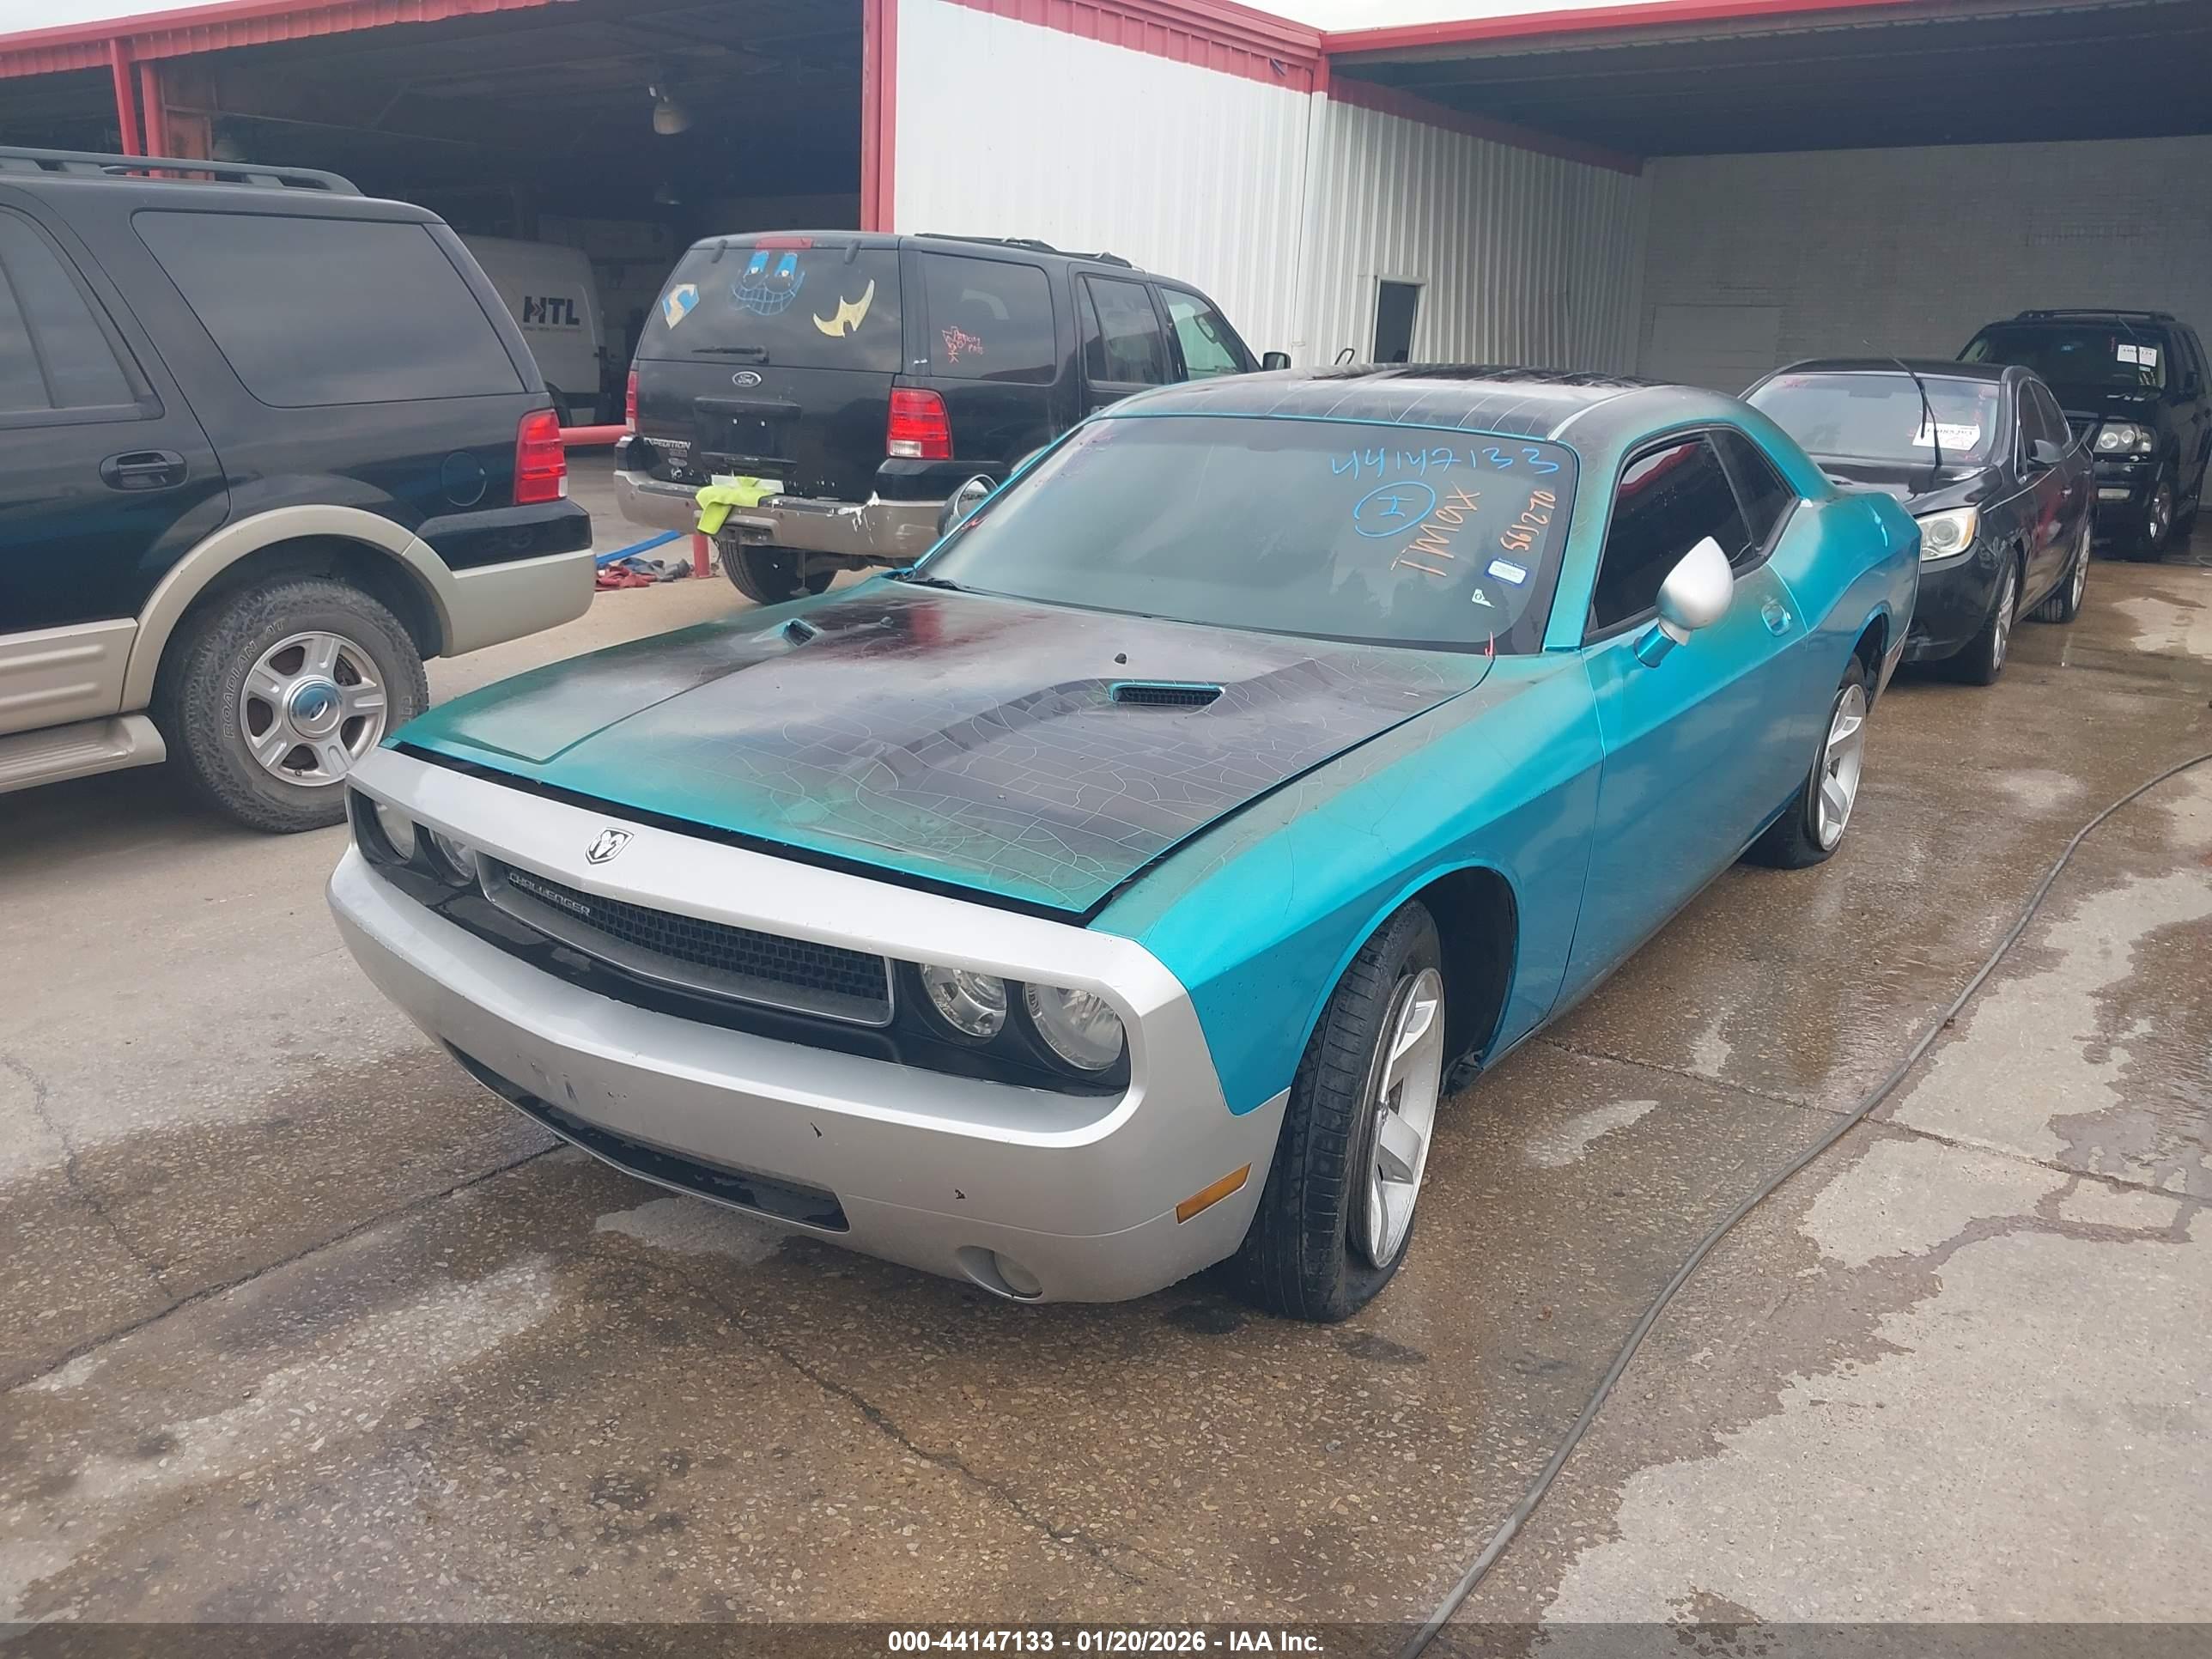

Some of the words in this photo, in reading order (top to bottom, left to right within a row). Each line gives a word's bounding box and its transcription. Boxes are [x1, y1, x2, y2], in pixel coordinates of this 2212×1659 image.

[523, 296, 580, 325] HTL
[1332, 447, 1559, 480] 44147133
[1500, 490, 1556, 551] 561270
[222, 640, 258, 738] ROADIAN
[508, 872, 591, 916] CHALLENGER
